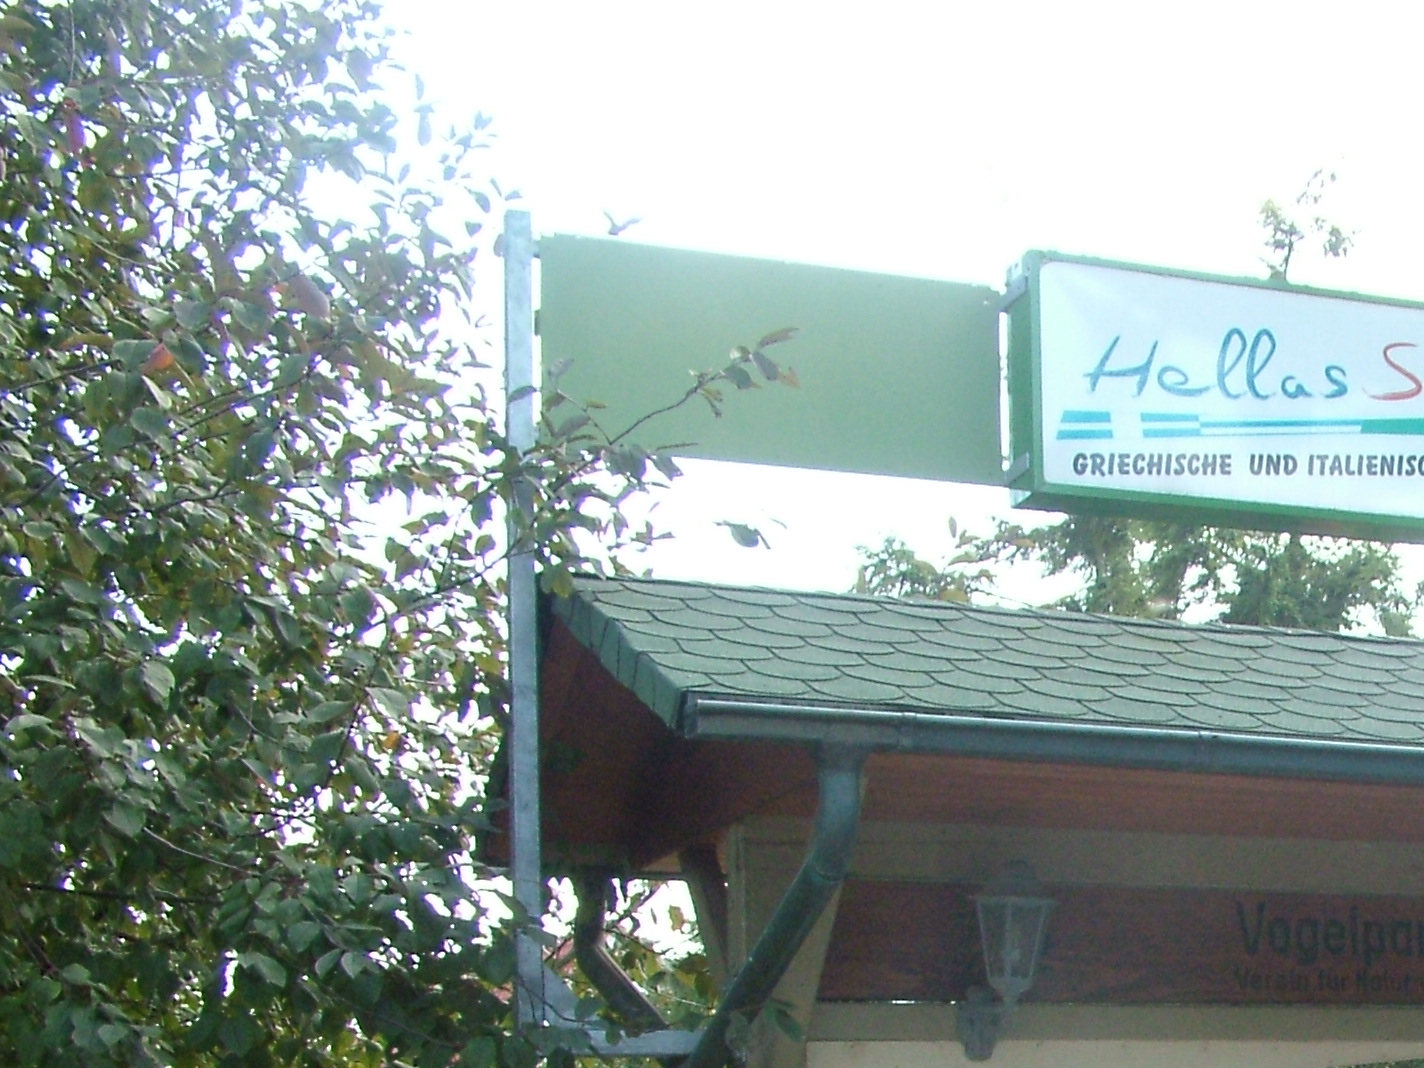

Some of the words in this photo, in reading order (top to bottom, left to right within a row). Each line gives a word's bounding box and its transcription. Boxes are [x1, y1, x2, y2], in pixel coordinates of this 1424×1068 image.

[1083, 328, 1348, 399] Hellas
[1072, 453, 1232, 477] GRIECHISCHE
[1250, 454, 1298, 476] UND
